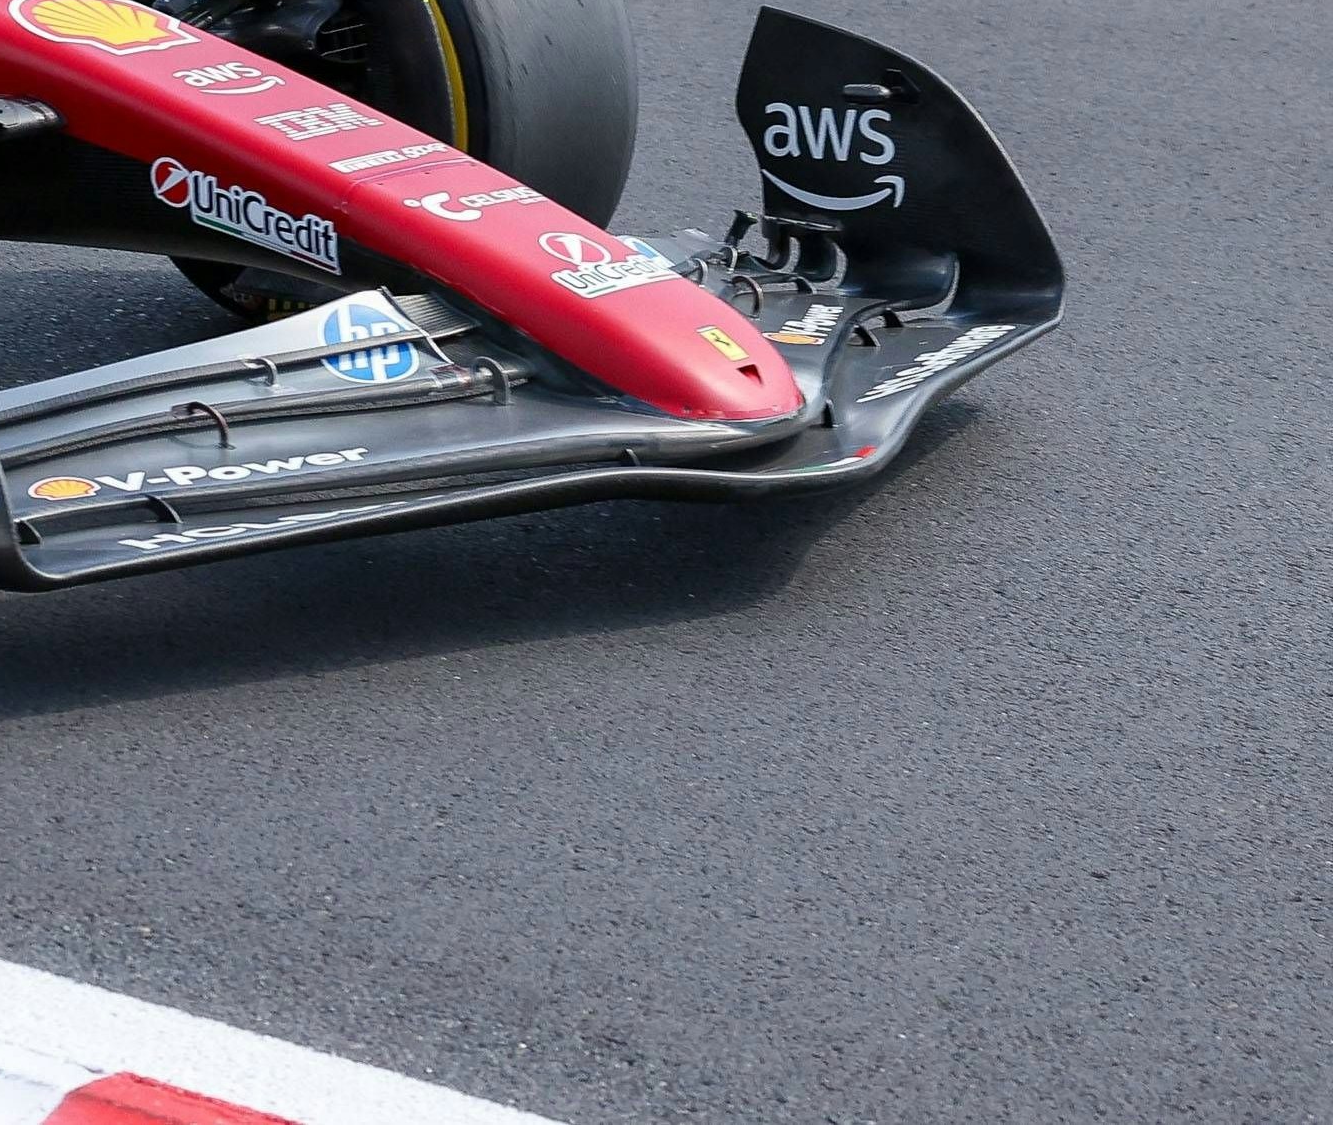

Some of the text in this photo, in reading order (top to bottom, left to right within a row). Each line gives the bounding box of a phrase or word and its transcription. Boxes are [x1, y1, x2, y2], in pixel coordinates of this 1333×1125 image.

[172, 62, 262, 87] aws
[763, 102, 896, 166] aws
[194, 174, 335, 261] UniCredit
[336, 304, 402, 380] hp
[95, 446, 369, 493] V-Power
